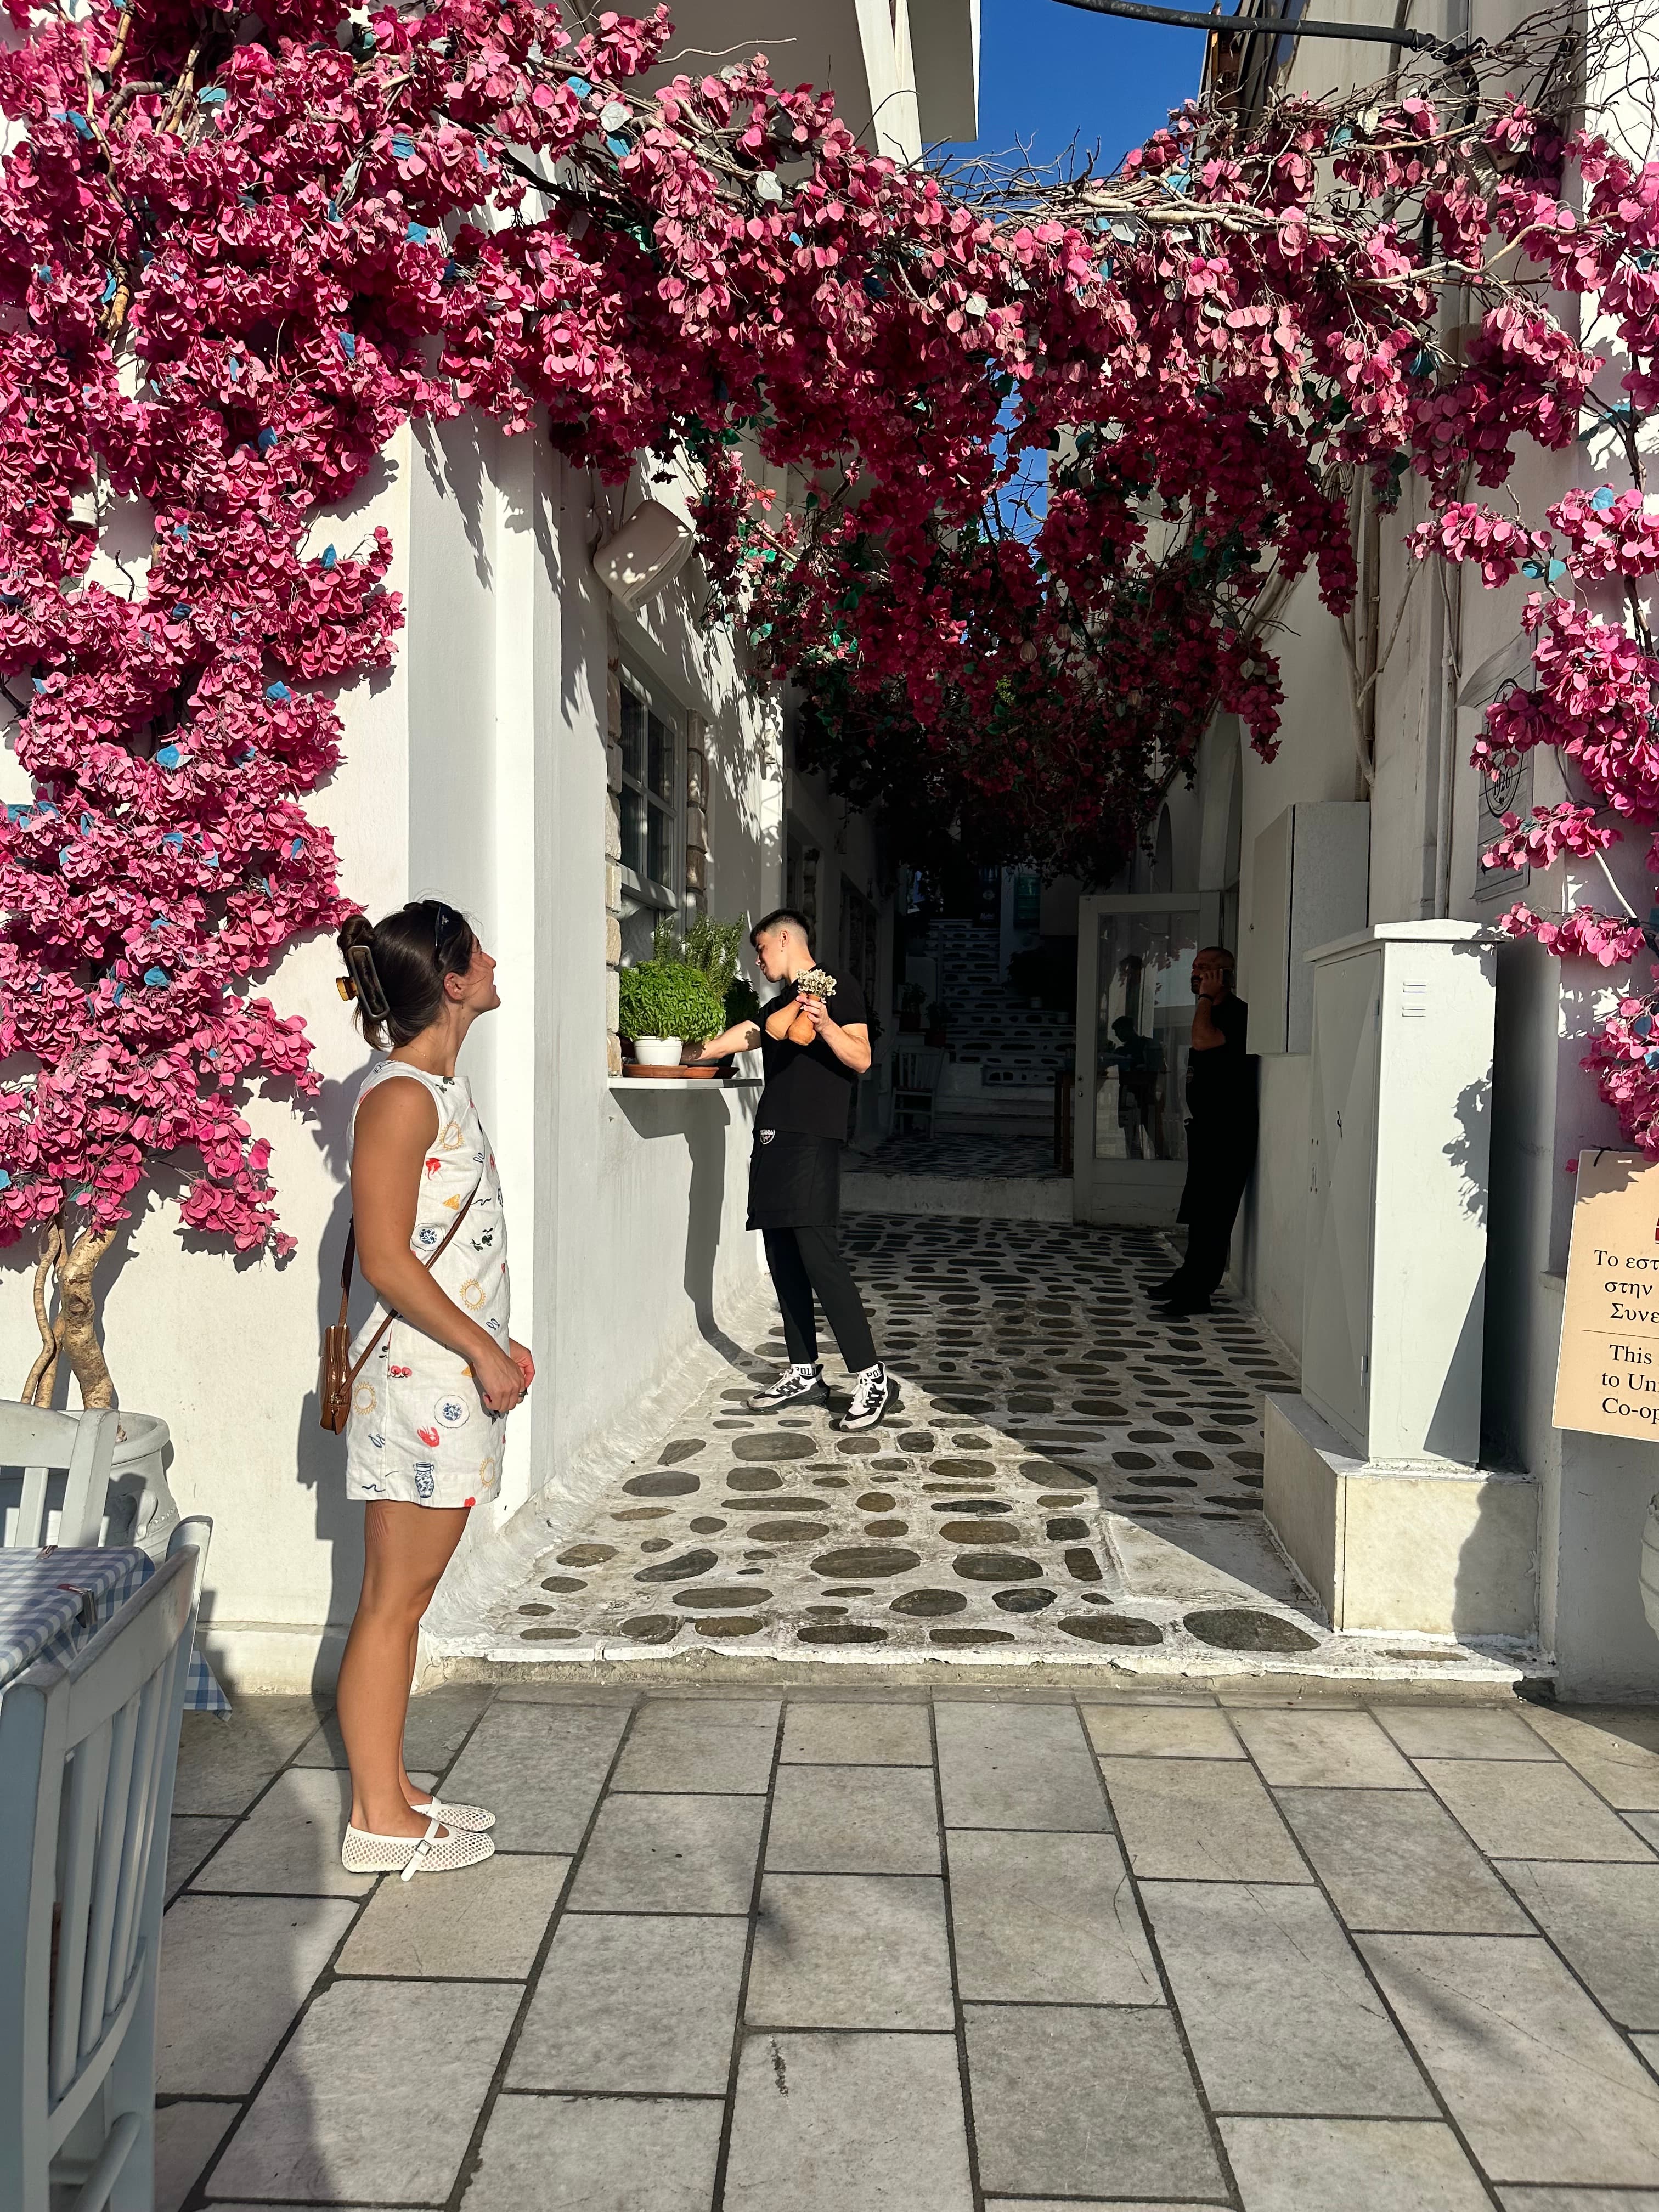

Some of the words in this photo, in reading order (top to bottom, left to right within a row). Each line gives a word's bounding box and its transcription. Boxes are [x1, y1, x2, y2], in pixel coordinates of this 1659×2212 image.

[1594, 1250, 1618, 1267] Το
[1626, 1257, 1659, 1271] εστ
[1605, 1282, 1653, 1299] στην
[1610, 1302, 1659, 1323] Συνε
[1609, 1344, 1652, 1364] This
[1602, 1373, 1620, 1387] to
[1628, 1373, 1659, 1392] Un
[1602, 1397, 1659, 1425] Co-op
